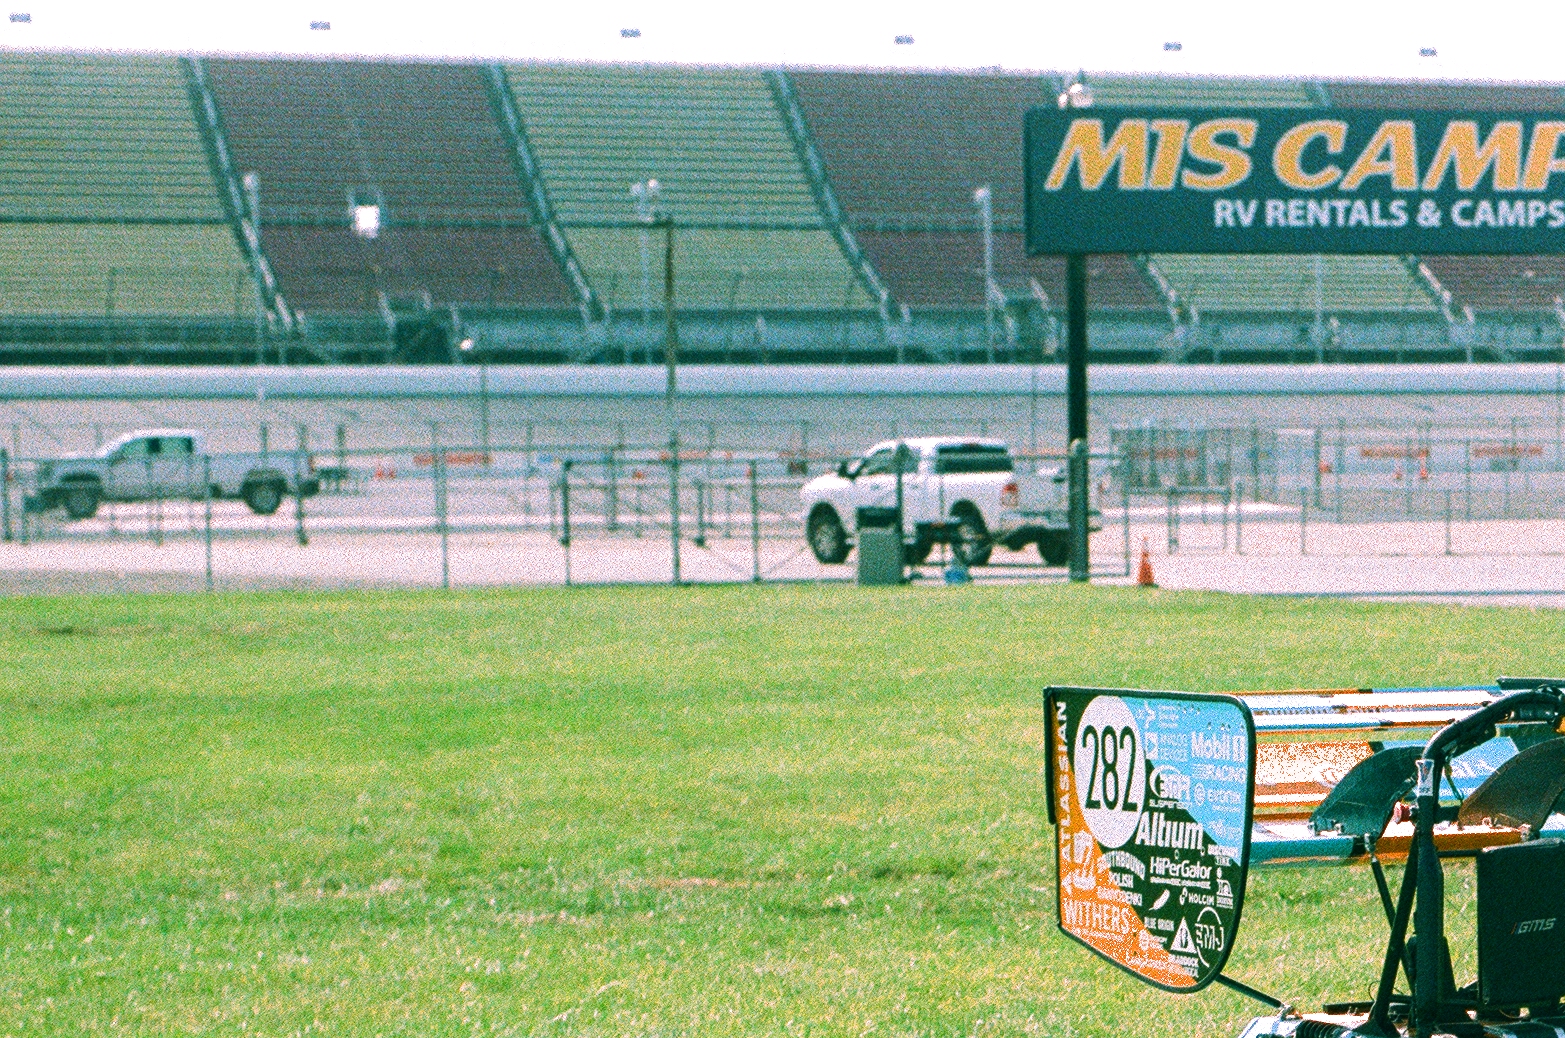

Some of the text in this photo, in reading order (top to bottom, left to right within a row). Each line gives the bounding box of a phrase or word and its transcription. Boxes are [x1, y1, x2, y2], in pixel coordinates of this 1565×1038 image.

[1044, 118, 1259, 191] MIS
[1214, 199, 1260, 228] RV
[1265, 199, 1407, 228] RENTALS
[1417, 199, 1441, 228] &
[1191, 731, 1230, 760] Mobil
[1056, 701, 1073, 861] ATLASSIAN
[1081, 725, 1138, 812] 282
[1135, 810, 1202, 850] Altium
[1150, 856, 1212, 880] HiPerGator
[1063, 897, 1131, 935] WITHERS
